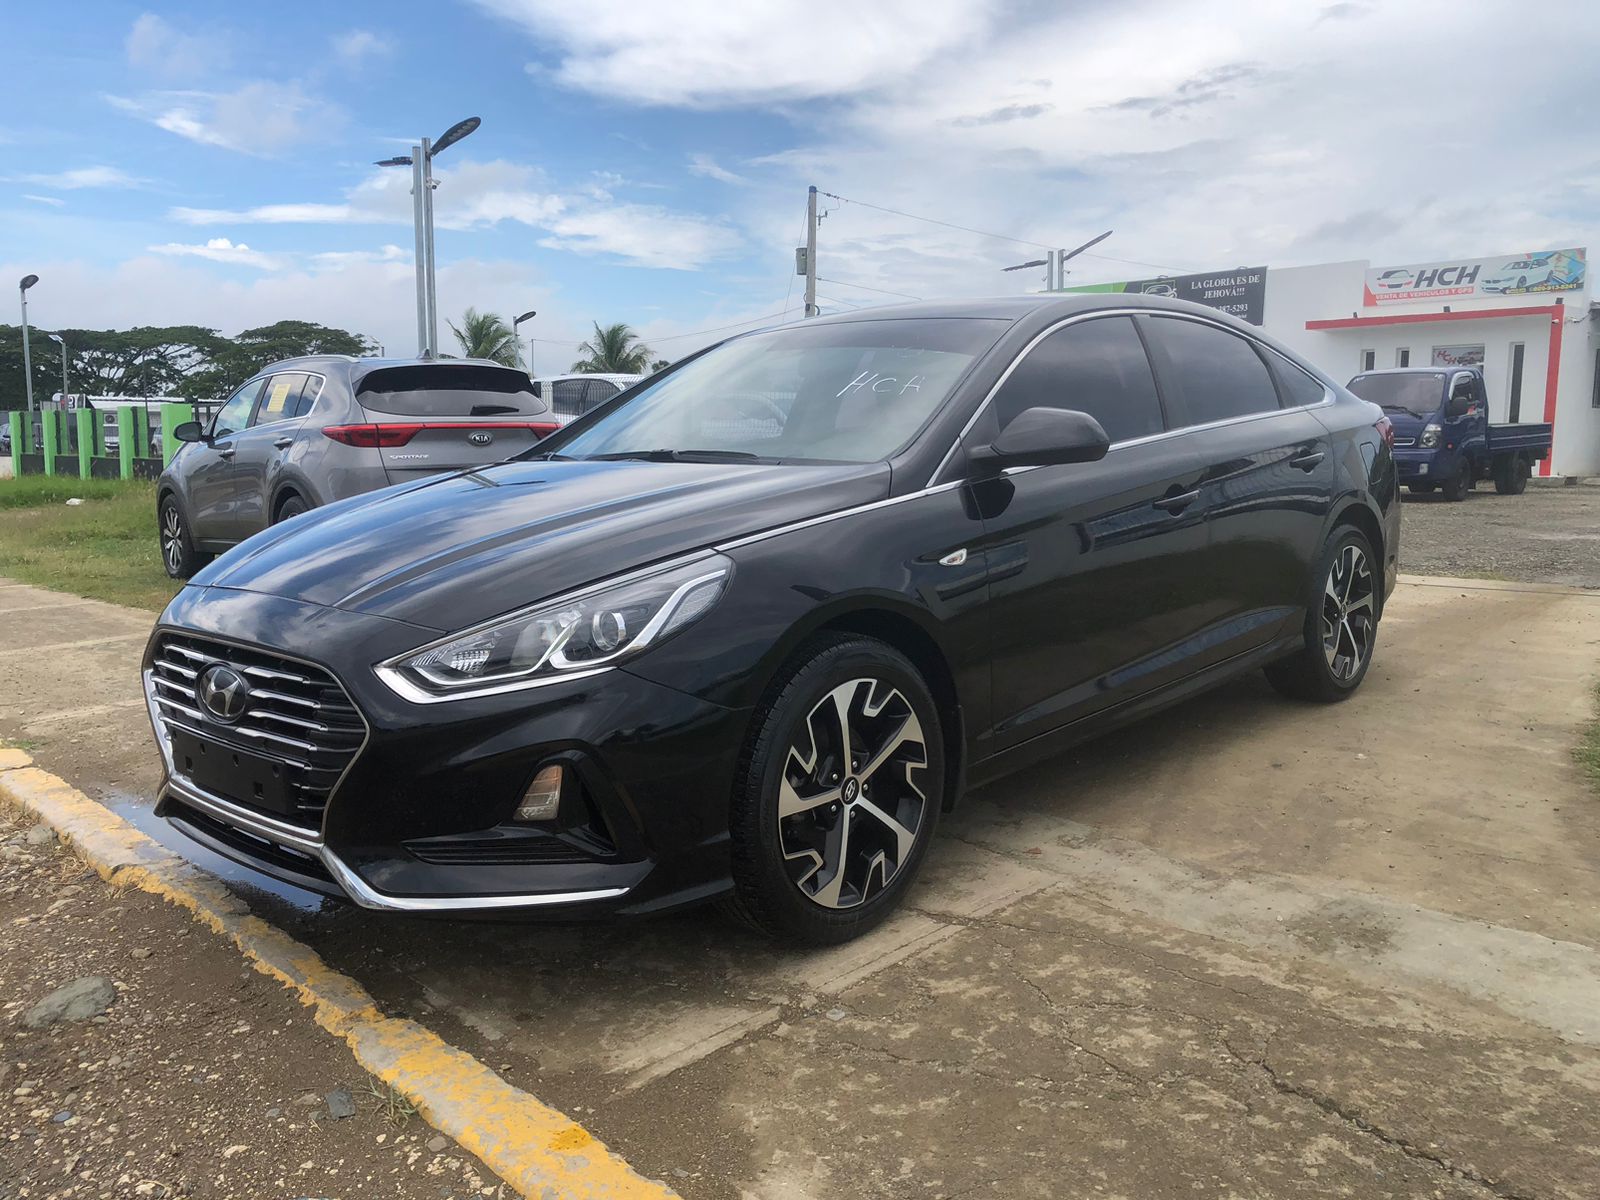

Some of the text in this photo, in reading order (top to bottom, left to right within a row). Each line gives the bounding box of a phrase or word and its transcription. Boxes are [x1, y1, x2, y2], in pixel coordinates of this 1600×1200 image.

[1191, 275, 1260, 290] LA GLORIA ES DE
[1414, 265, 1481, 288] HCH
[1203, 286, 1245, 299] JEHOVÁ!!!
[1375, 292, 1398, 300] VENTA
